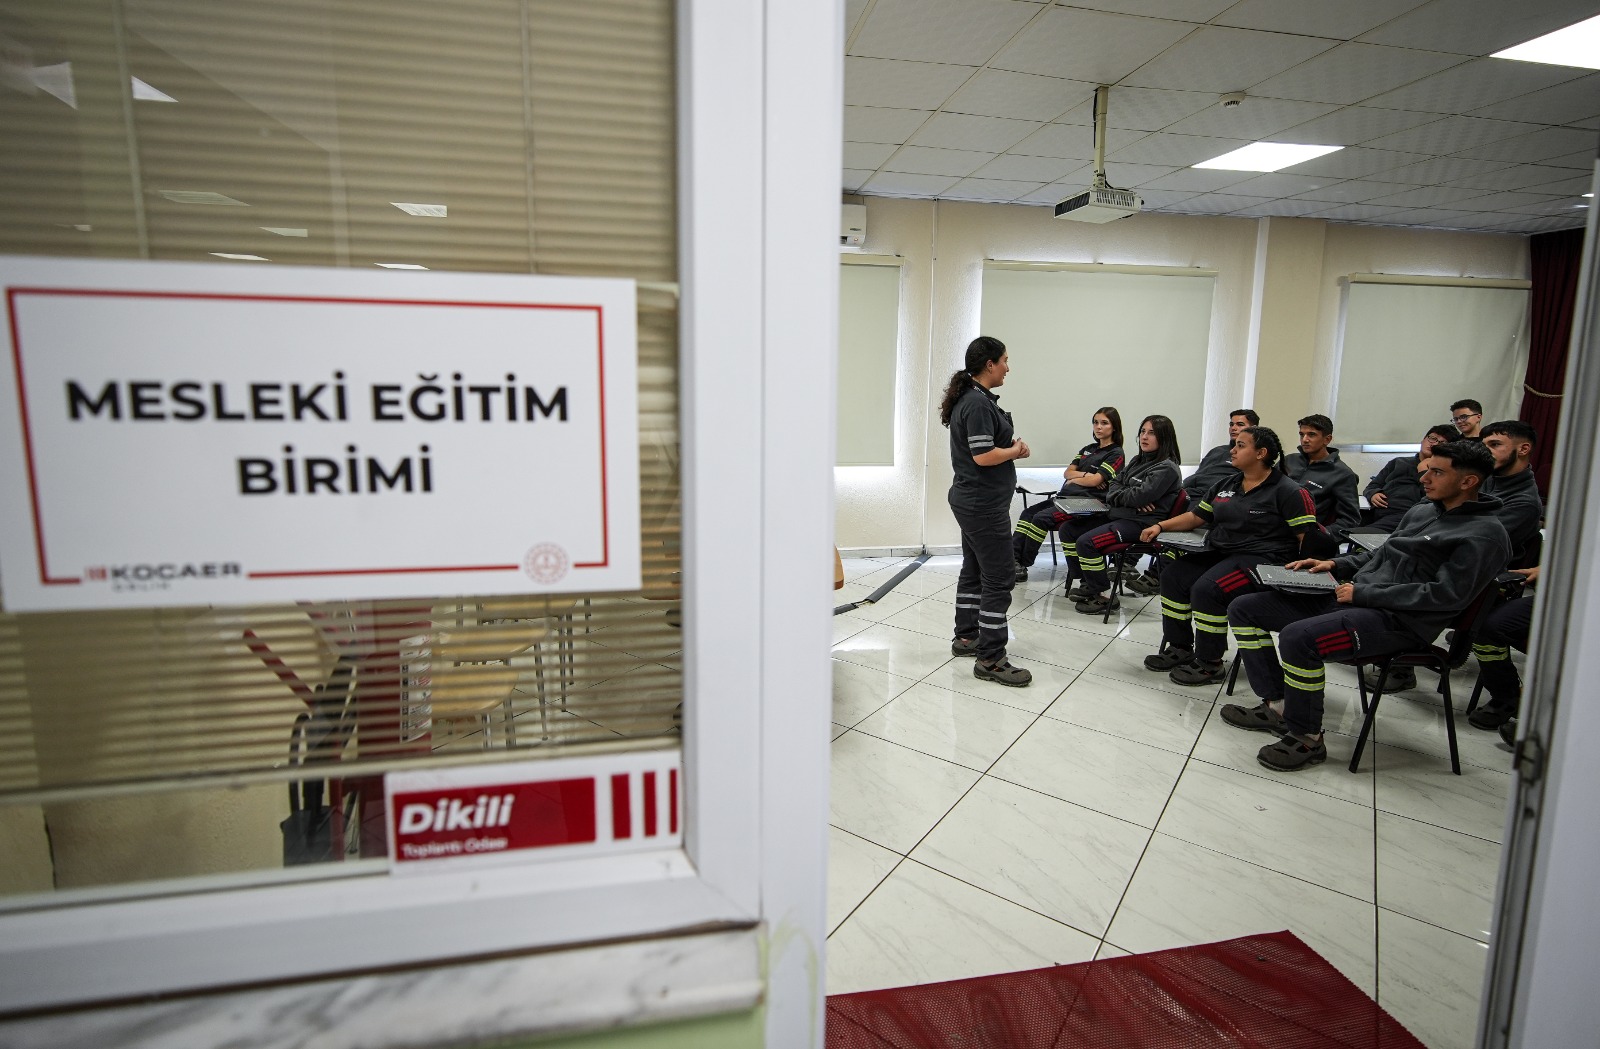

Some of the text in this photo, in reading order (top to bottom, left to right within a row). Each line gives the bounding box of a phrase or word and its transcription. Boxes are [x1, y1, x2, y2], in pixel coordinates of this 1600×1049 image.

[64, 371, 569, 423] MESLEKİ EĞİTİM
[237, 444, 433, 496] BİRİMİ
[110, 562, 241, 581] KOCAER
[399, 794, 515, 835] Dikili
